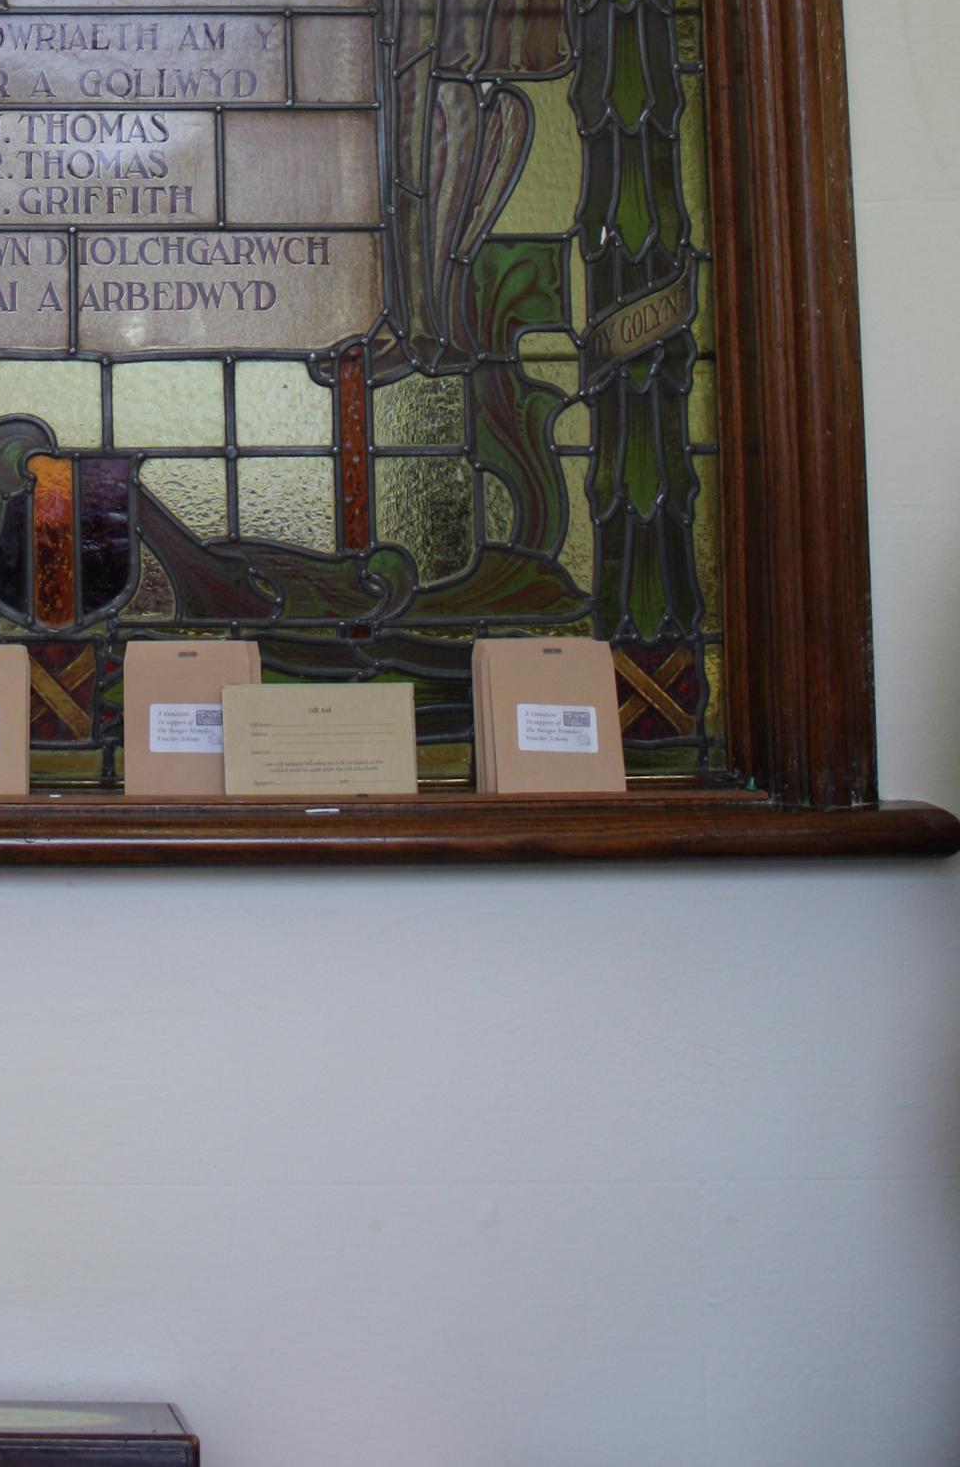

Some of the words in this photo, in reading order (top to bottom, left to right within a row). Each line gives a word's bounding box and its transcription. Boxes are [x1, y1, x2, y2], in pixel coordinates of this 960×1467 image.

[178, 22, 227, 51] AM
[254, 22, 279, 51] Y
[29, 69, 57, 98] A
[78, 68, 259, 99] GOLLWYD
[18, 113, 171, 145] THOMAS
[16, 149, 169, 180] THOMAS
[17, 184, 193, 216] GRIFFITH
[37, 282, 64, 312] A
[78, 280, 277, 312] ARBEDWYD
